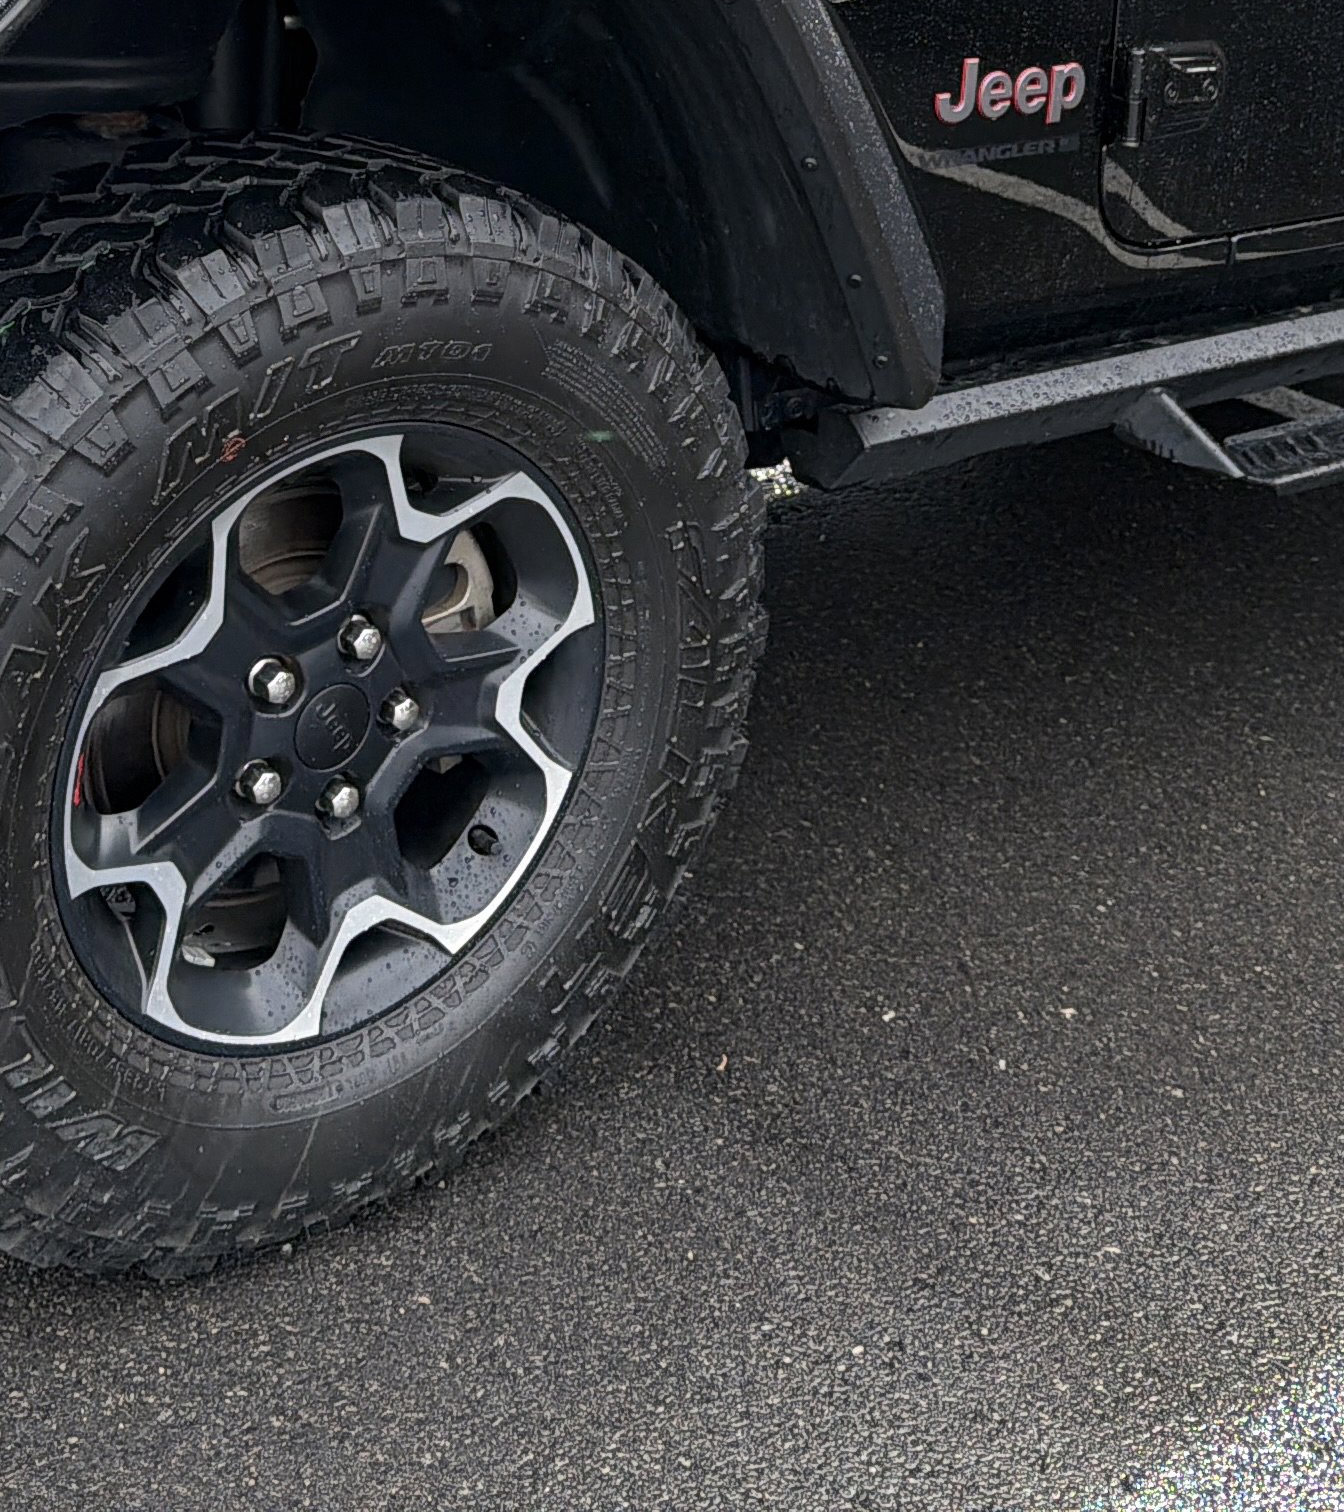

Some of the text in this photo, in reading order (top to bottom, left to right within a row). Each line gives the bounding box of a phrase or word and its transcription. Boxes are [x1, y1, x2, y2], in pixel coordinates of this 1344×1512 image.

[935, 57, 1086, 126] Jeep
[918, 139, 1056, 169] WRANGLER
[315, 702, 354, 752] Jeep
